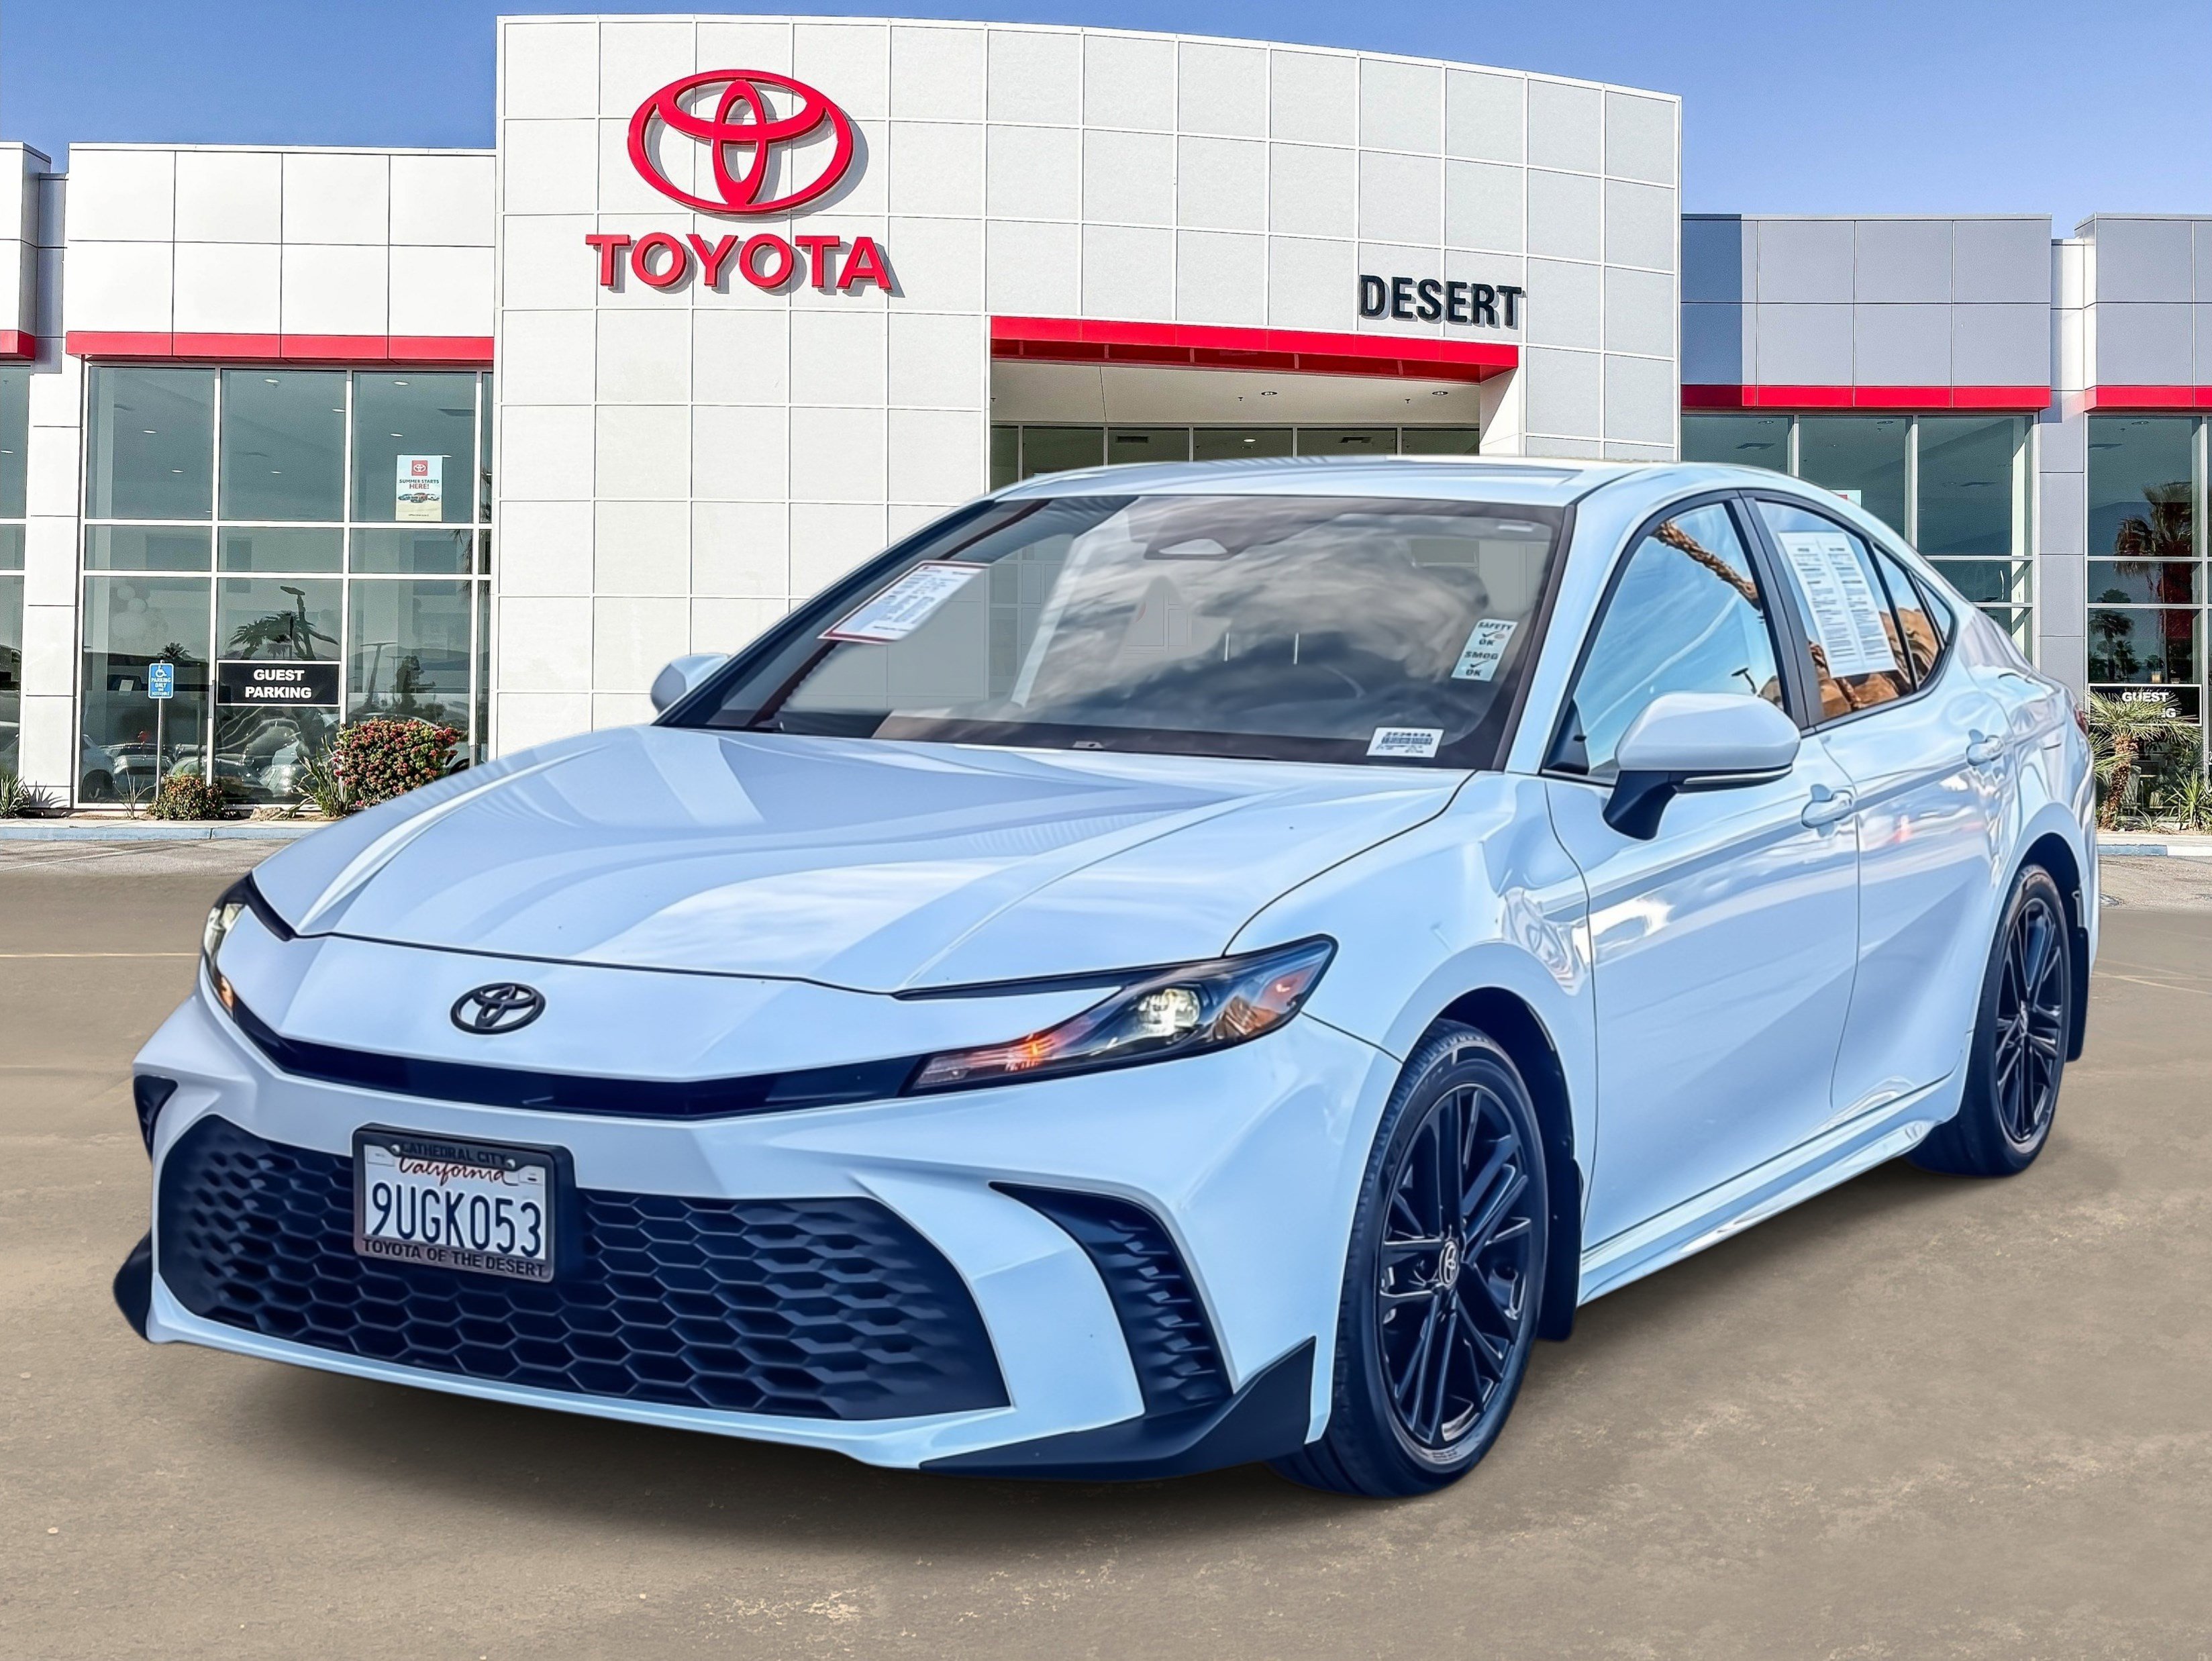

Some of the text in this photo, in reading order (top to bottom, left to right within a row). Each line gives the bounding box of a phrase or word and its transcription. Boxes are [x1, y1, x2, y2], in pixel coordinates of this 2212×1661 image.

[585, 232, 893, 291] TOYOTA
[1359, 274, 1522, 327] DESERT
[1478, 621, 1513, 630] SAFETY
[1464, 651, 1499, 660] SMOG
[253, 669, 305, 681] GUEST
[245, 686, 312, 699] PARKING
[2121, 691, 2169, 703] GUEST
[402, 1142, 507, 1165] CATHEDRAL CITY
[399, 1156, 519, 1187] California
[372, 1182, 542, 1258] 9UGK053
[362, 1238, 547, 1277] TOYOTA OF THE DESERT
